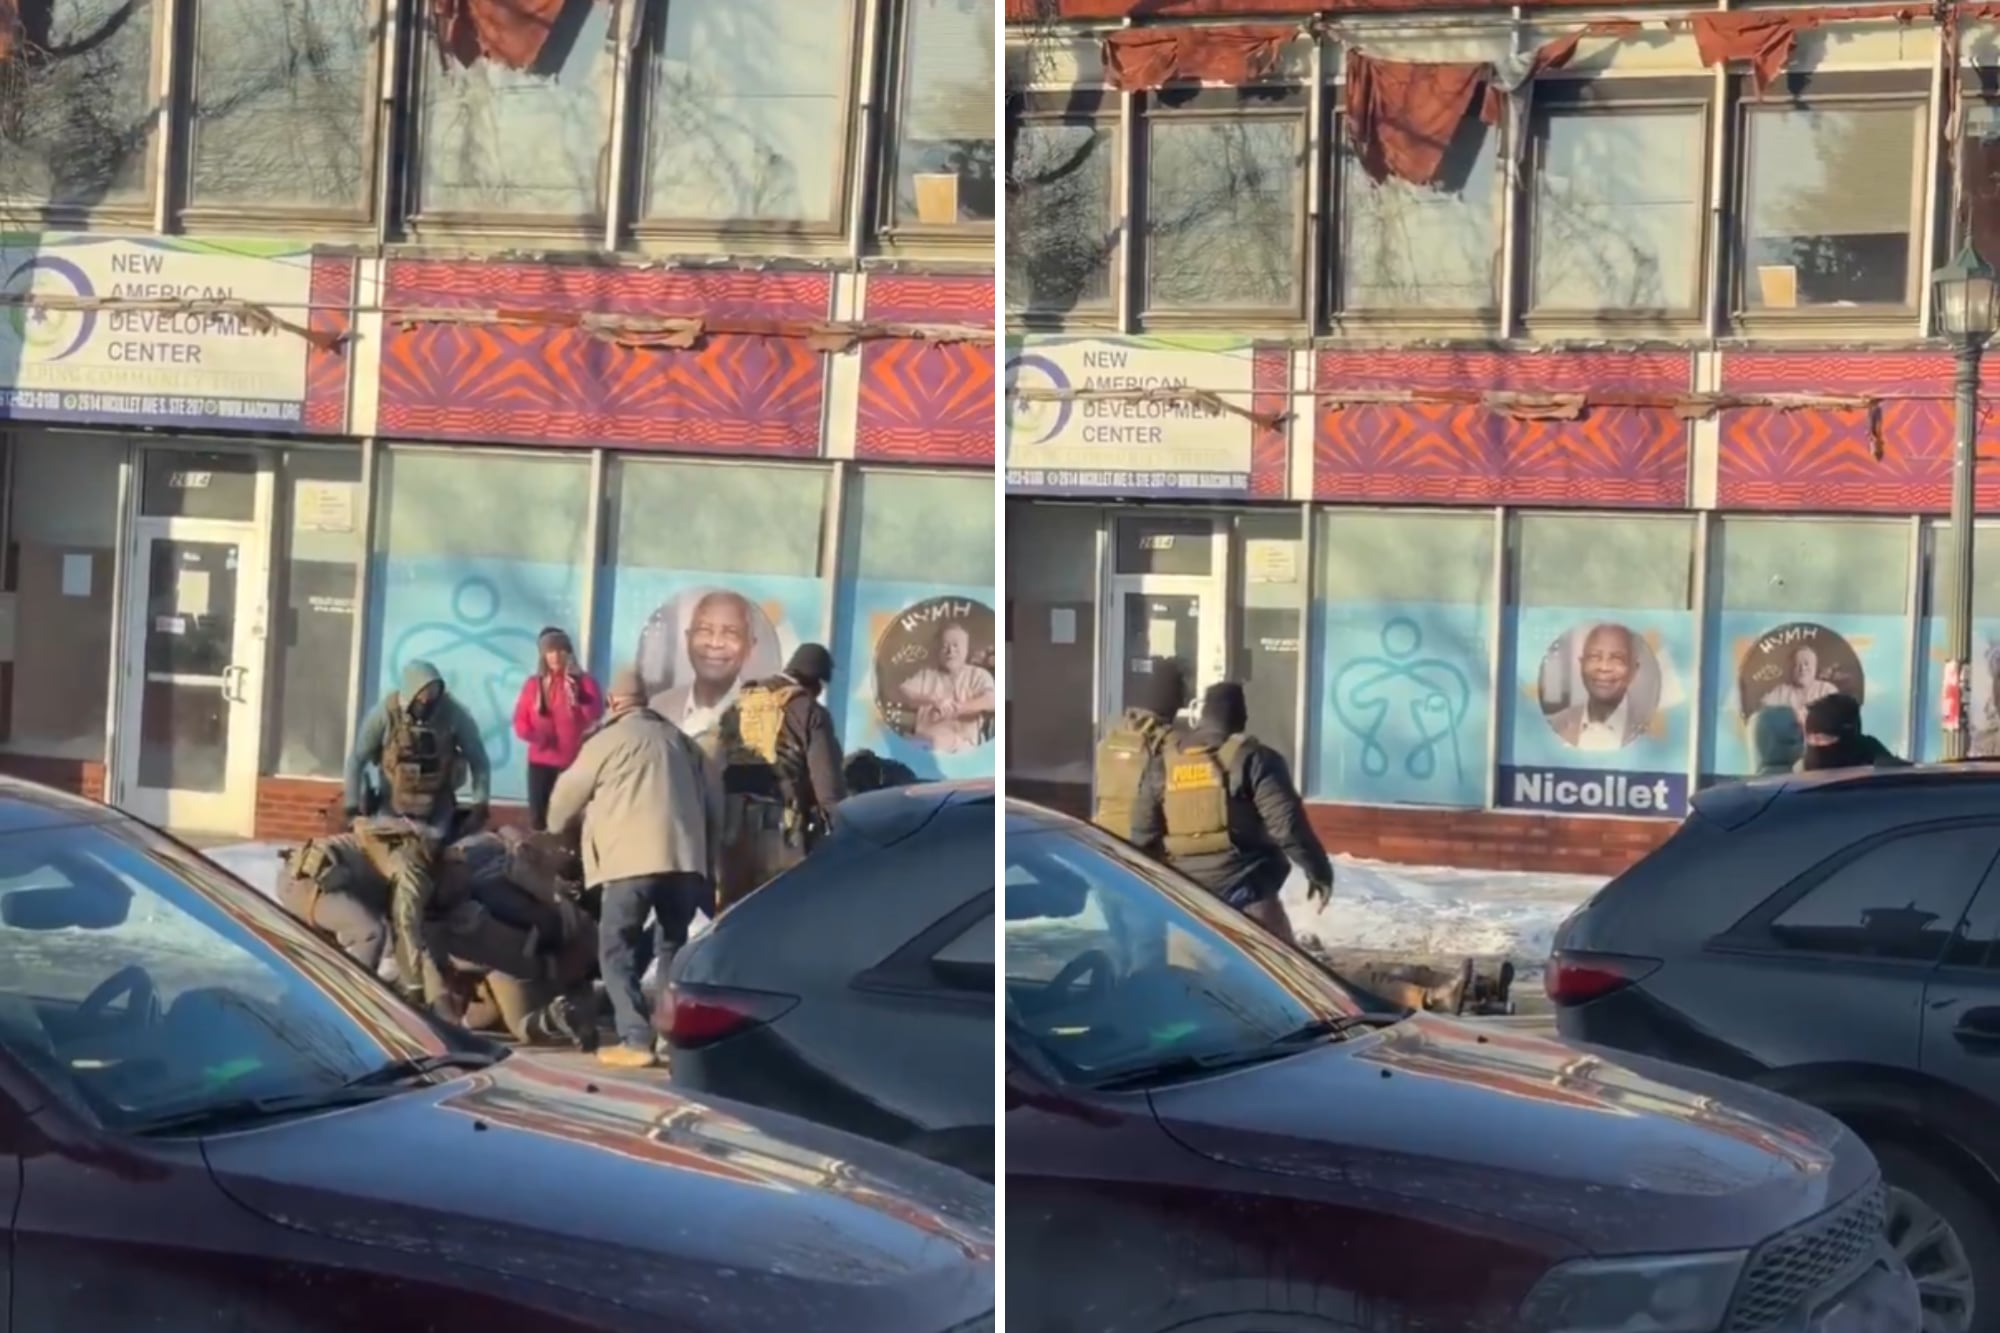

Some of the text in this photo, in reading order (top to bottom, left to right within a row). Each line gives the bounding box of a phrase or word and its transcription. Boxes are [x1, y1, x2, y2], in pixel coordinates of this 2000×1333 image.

[111, 253, 164, 275] NEW
[111, 283, 234, 301] AMERICAN
[109, 312, 280, 337] DEVELOPME
[107, 341, 202, 364] CENTER
[1082, 351, 1129, 370] NEW
[1083, 375, 1189, 390] AMERICAN
[1082, 425, 1162, 443] CENTER
[1514, 770, 1670, 812] Nicollet
